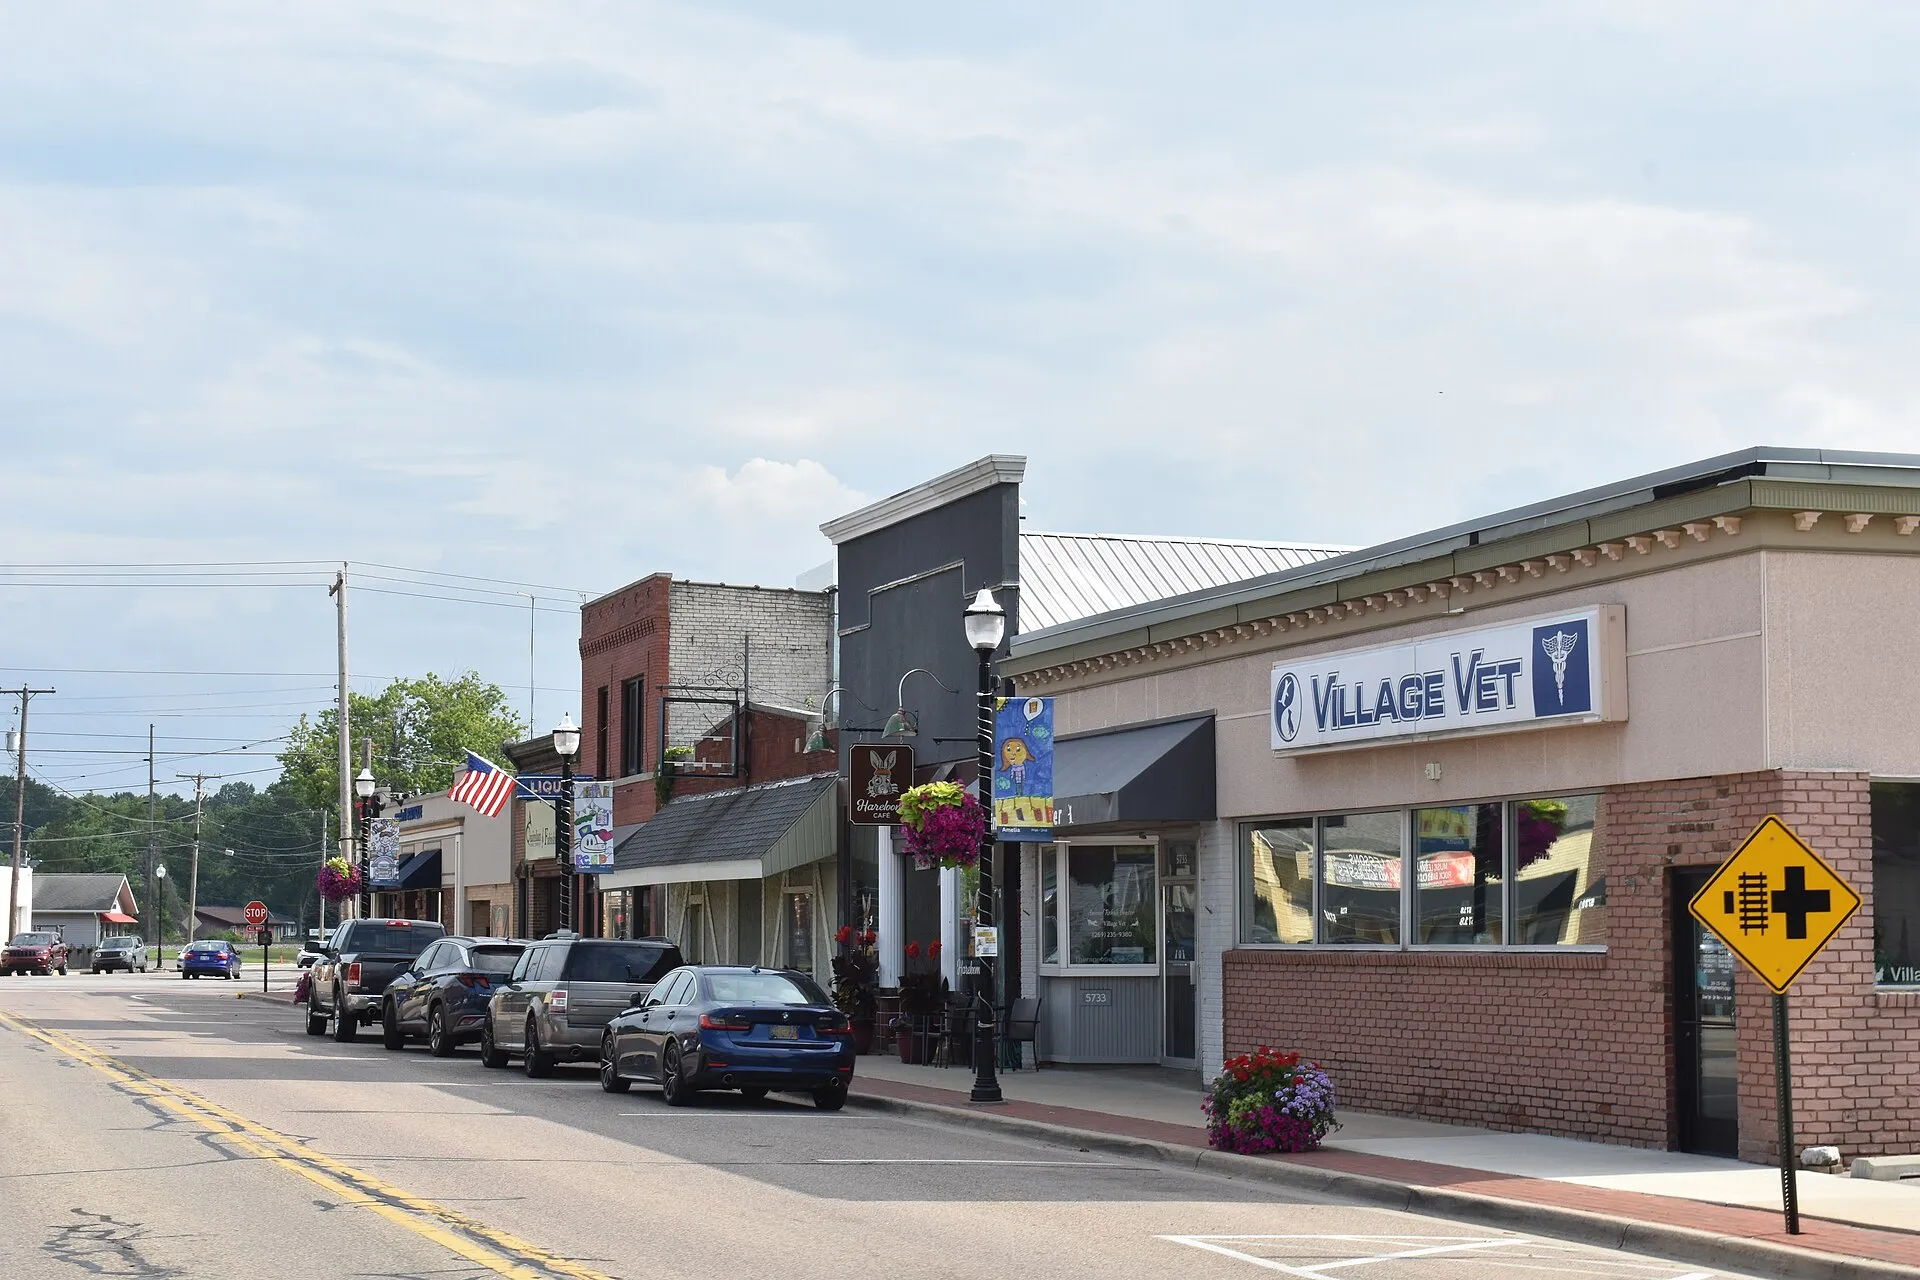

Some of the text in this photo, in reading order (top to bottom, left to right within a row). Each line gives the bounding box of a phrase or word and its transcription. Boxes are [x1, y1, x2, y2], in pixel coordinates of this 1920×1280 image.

[1310, 648, 1523, 732] VILLAGE VET
[246, 909, 266, 917] STOP
[1085, 993, 1106, 1002] 5733
